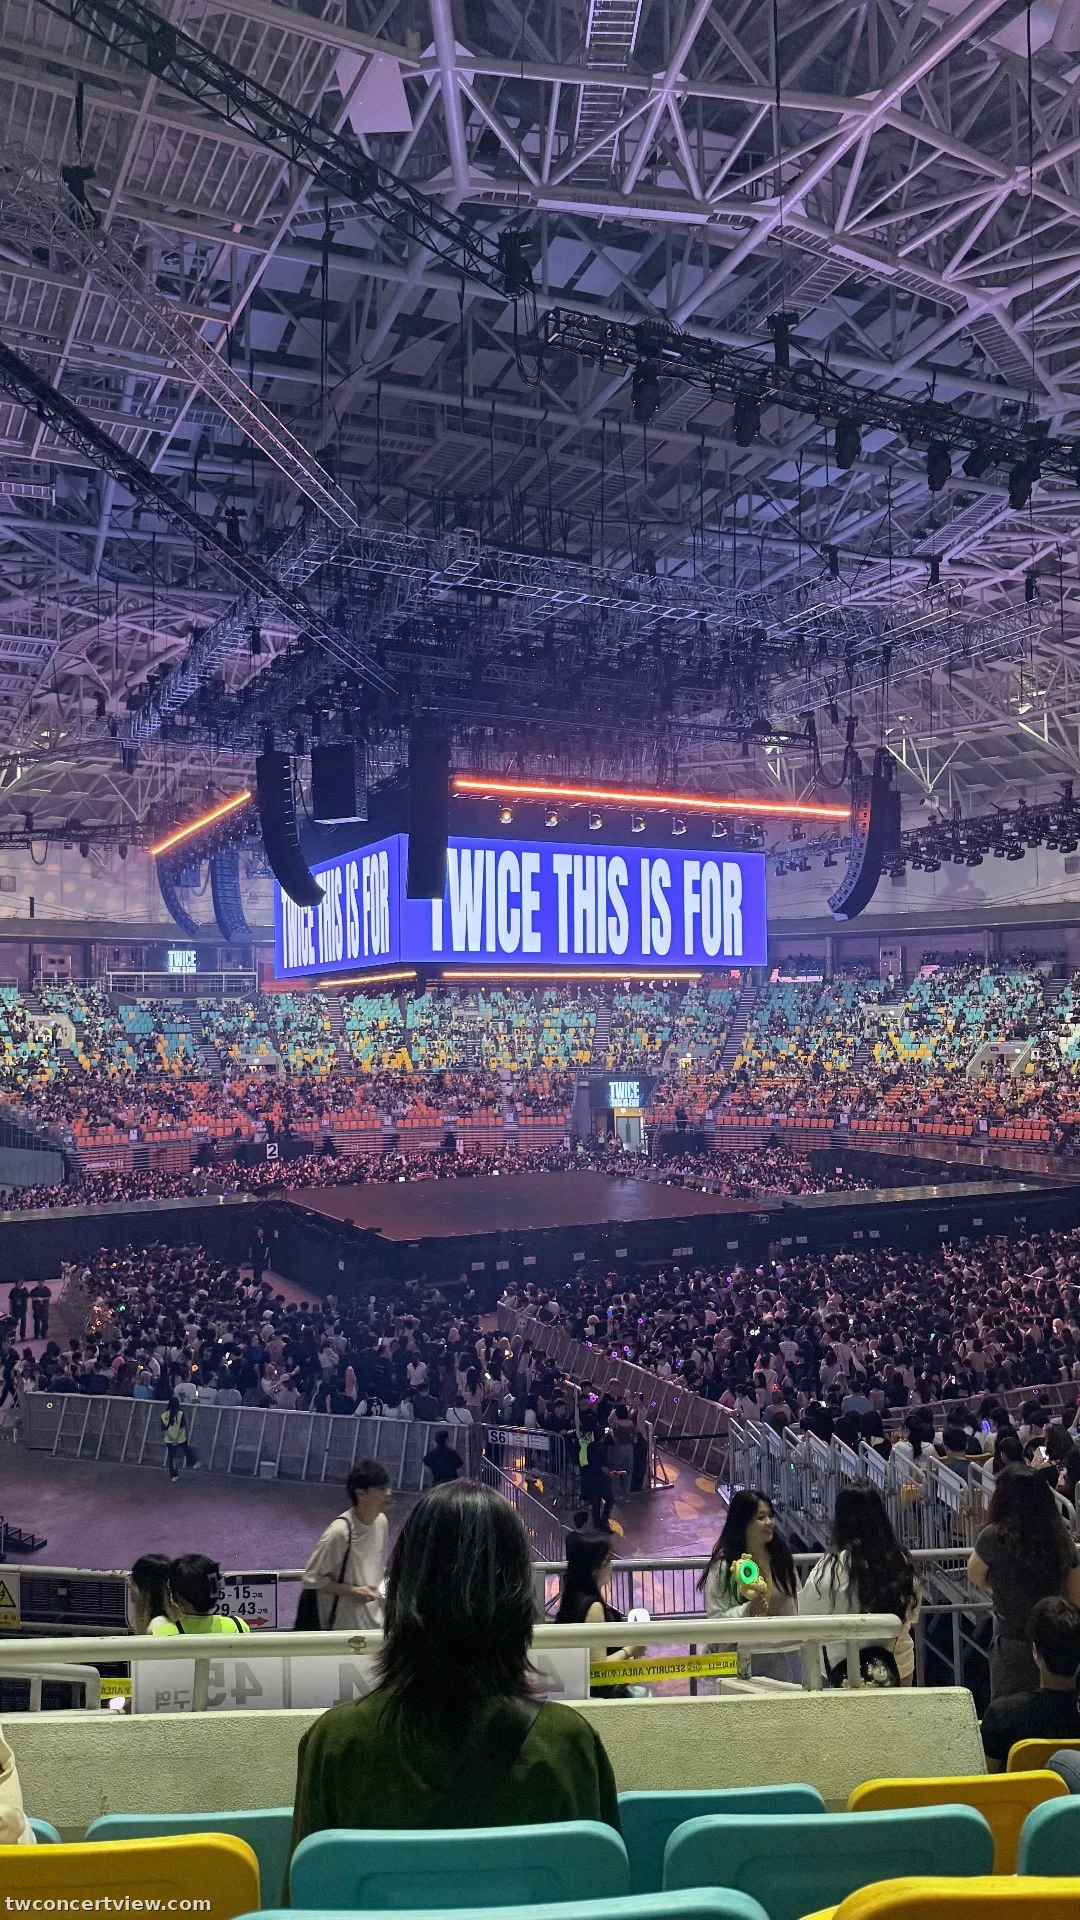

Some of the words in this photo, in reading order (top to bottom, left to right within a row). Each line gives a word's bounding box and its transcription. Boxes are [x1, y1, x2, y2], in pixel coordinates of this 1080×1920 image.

[315, 866, 343, 964] THIS
[345, 861, 360, 959] IS
[362, 850, 390, 957] FOR
[552, 854, 629, 956] THIS
[640, 858, 672, 956] IS
[684, 859, 744, 957] FOR
[168, 950, 197, 967] TWICE
[609, 1081, 640, 1099] TWICE
[267, 1144, 277, 1157] 2
[490, 1430, 506, 1444] S6
